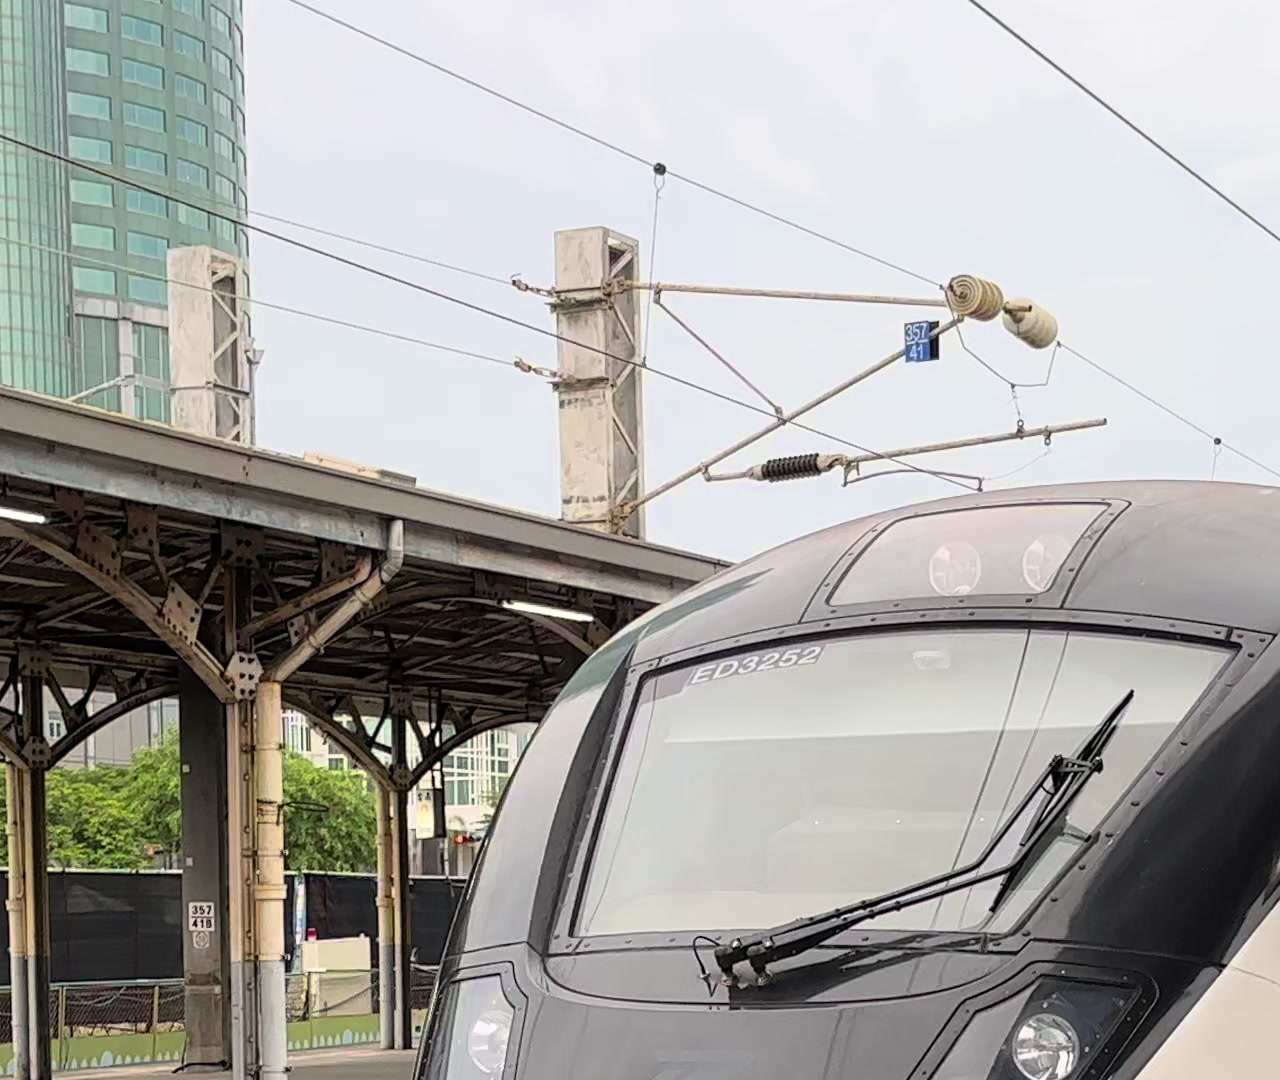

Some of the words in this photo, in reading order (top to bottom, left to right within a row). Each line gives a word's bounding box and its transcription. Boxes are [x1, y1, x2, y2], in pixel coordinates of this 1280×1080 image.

[905, 323, 927, 341] 357
[910, 344, 924, 360] 41
[690, 647, 821, 684] ED3252
[191, 904, 212, 915] 357
